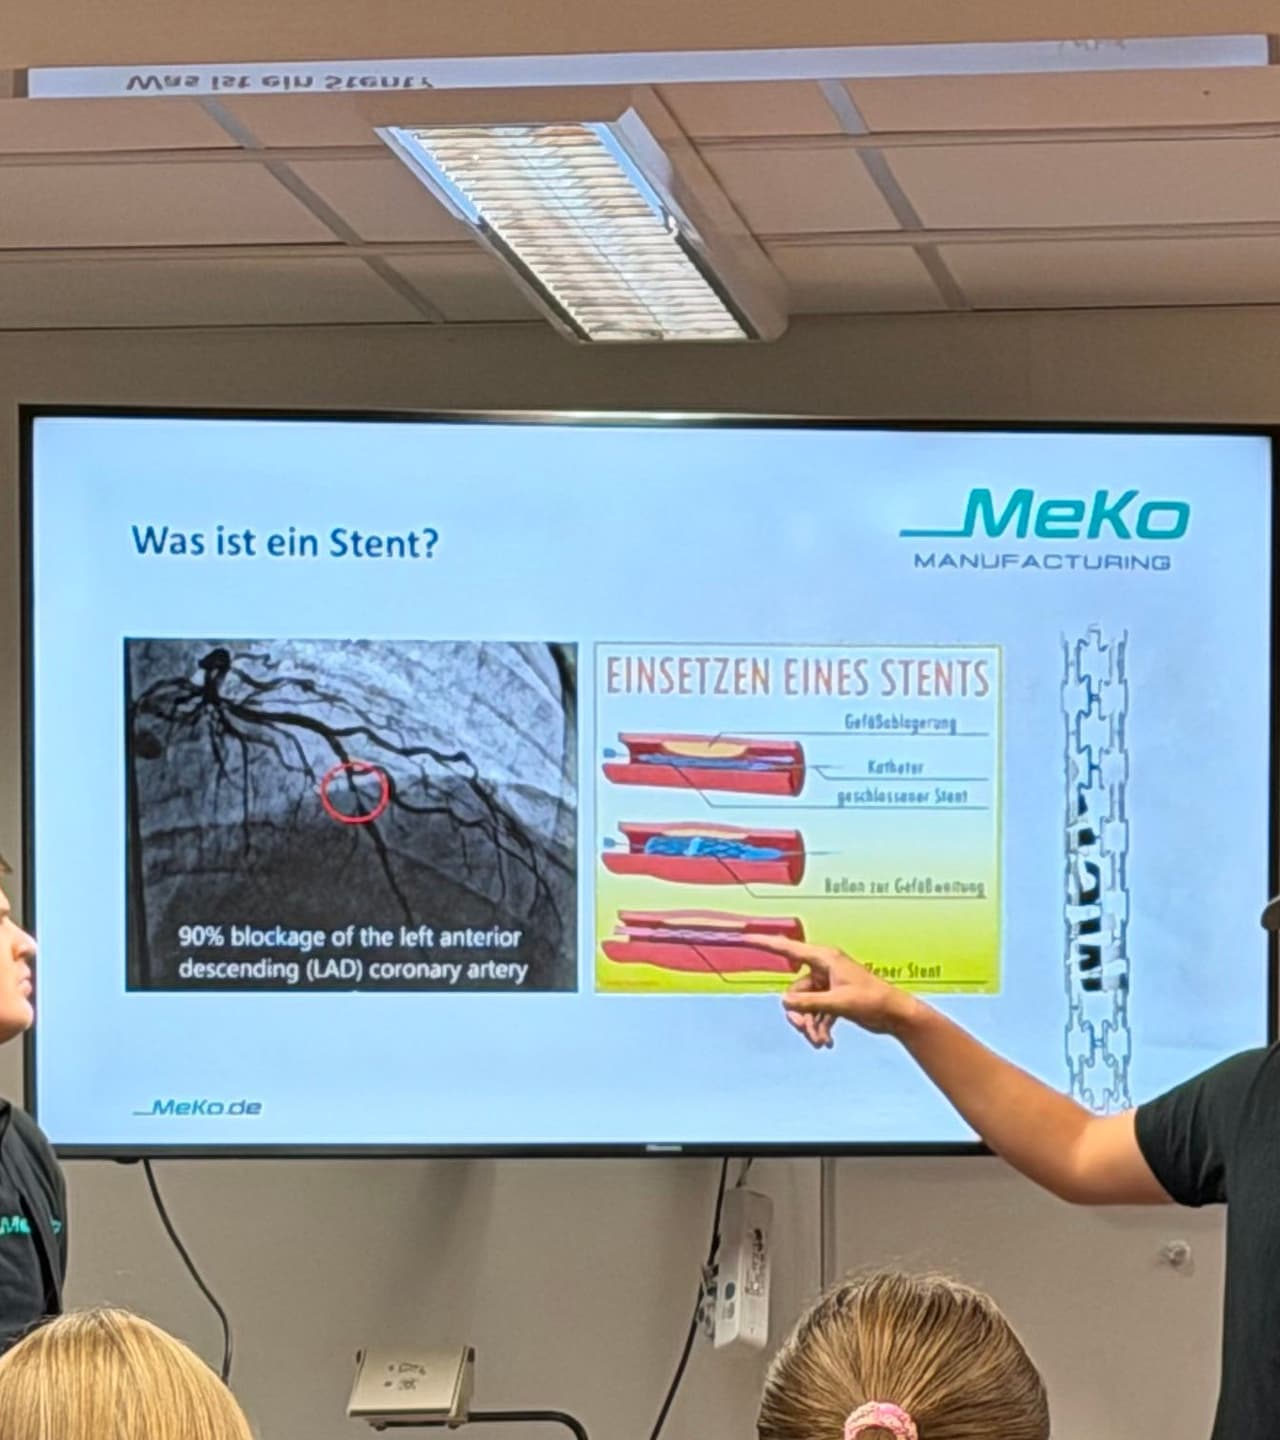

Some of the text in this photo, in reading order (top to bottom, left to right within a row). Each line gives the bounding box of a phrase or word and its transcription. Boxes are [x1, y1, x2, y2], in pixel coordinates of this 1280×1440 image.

[899, 488, 1190, 539] MeKo
[132, 525, 439, 558] Was ist ein Stent?
[914, 554, 1171, 570] MANUFACTURING
[607, 656, 989, 697] EINSETZEN EINES STENTS
[868, 758, 924, 774] Katheter
[837, 787, 968, 808] geschlossener Stent
[870, 881, 889, 893] zur
[178, 925, 522, 952] 90% blockage of the left anterior
[179, 958, 528, 985] descending (LAD) coronary artery
[907, 962, 942, 978] Stent
